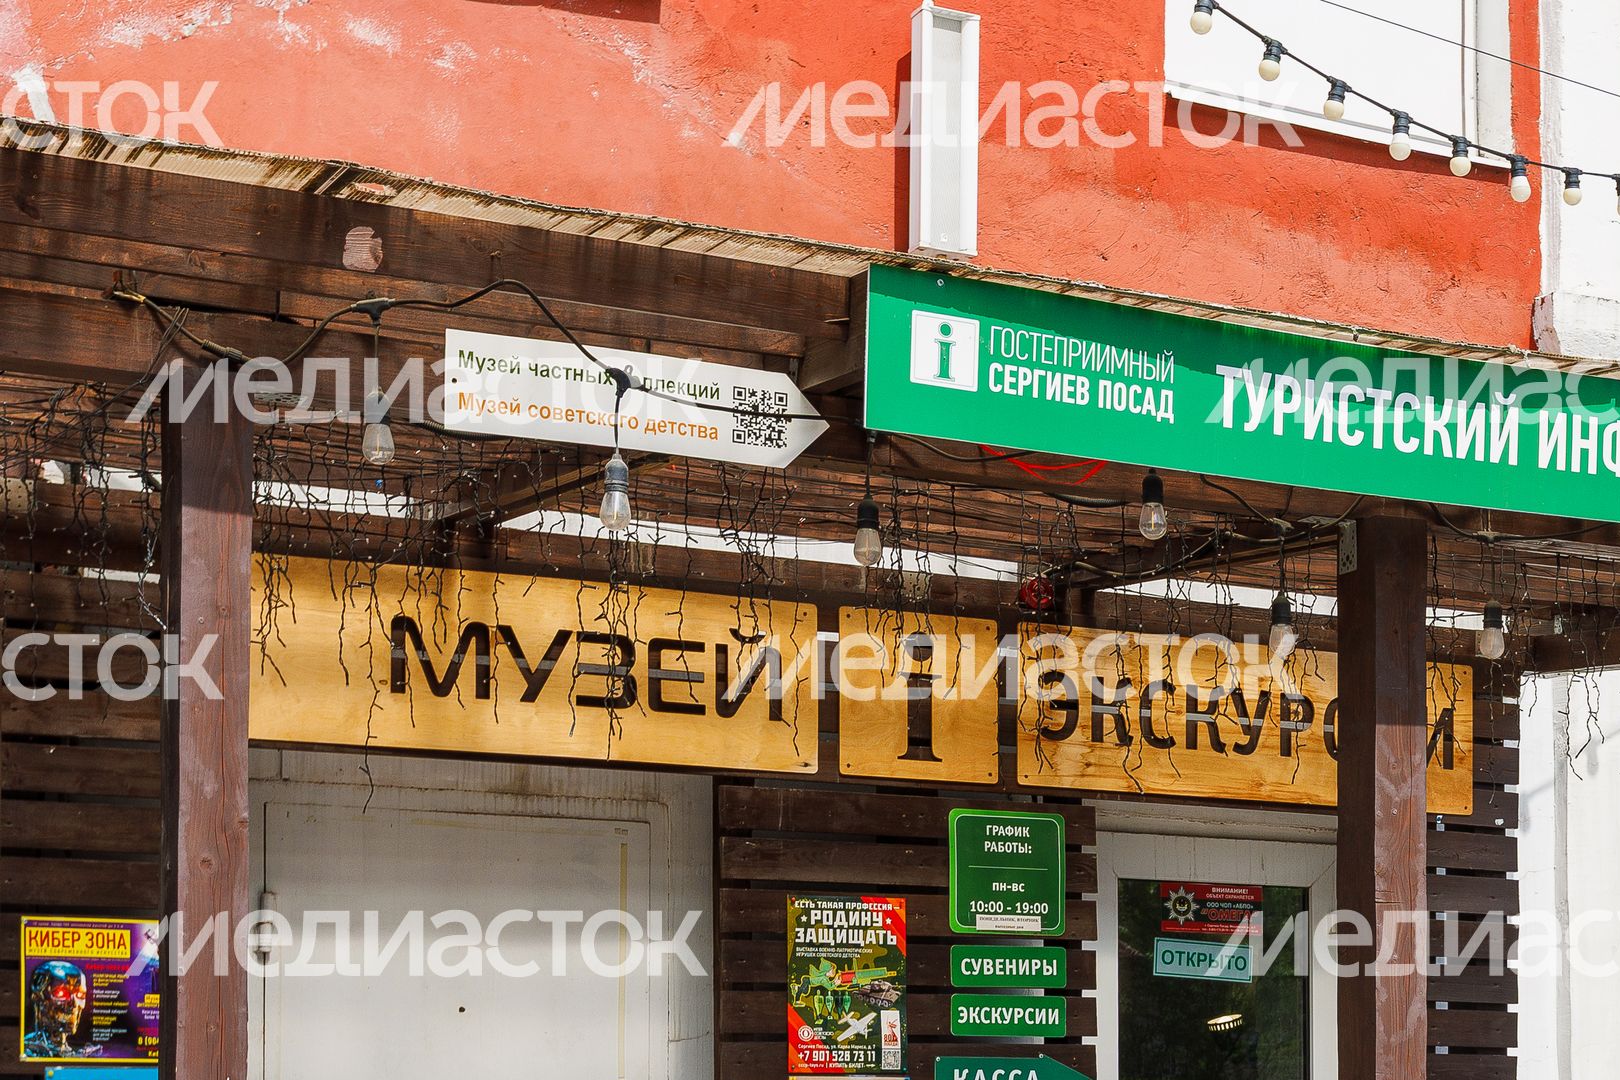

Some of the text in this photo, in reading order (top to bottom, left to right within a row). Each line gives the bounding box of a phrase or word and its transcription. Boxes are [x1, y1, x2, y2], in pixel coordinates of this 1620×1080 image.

[990, 325, 1175, 384] ГОСТЕПРИИМНЫЙ
[458, 350, 720, 400] Музей частных ллекций
[988, 362, 1175, 424] СЕРГИЕВ ПОСАД
[458, 392, 719, 441] Музей советского детства
[1215, 363, 1519, 467] ТУРИСТСКИЙ
[389, 615, 783, 722] МУЗЕЙ
[1039, 670, 1455, 771] ЭКСКУРИ
[986, 825, 1030, 838] ГРАФИК
[984, 841, 1032, 854] РАБОТЫ:
[795, 900, 892, 911] ЕСТЬ ТАКАЯ ПРОФЕССИЯ
[969, 900, 1004, 913] 10:00
[1015, 902, 1049, 914] 19:00
[810, 910, 883, 928] РОДИНУ
[28, 930, 127, 950] КИБЕР ЗОНА
[795, 927, 897, 946] ЗАЩИЩАТЬ
[960, 958, 1057, 976] СУВЕНИРЫ
[1161, 949, 1247, 971] ОТКРЫТО
[957, 1006, 1059, 1025] ЭКСКУРСИИ
[798, 1050, 876, 1062] +7 901 528 73 11
